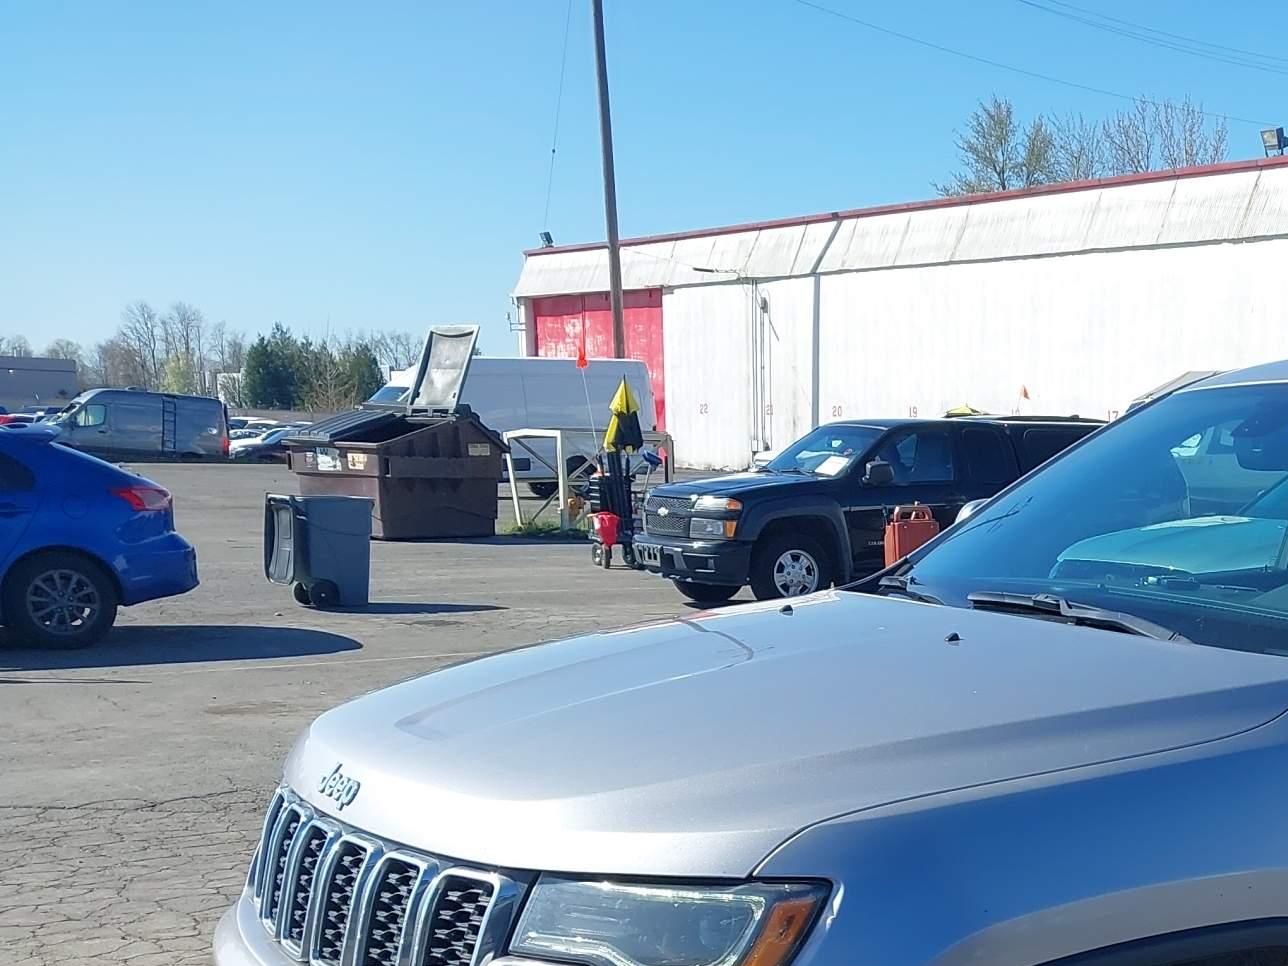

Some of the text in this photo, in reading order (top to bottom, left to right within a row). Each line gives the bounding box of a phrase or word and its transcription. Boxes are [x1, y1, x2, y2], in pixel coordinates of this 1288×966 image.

[832, 405, 843, 417] 20
[908, 406, 918, 418] 19
[318, 763, 361, 811] Jeep
